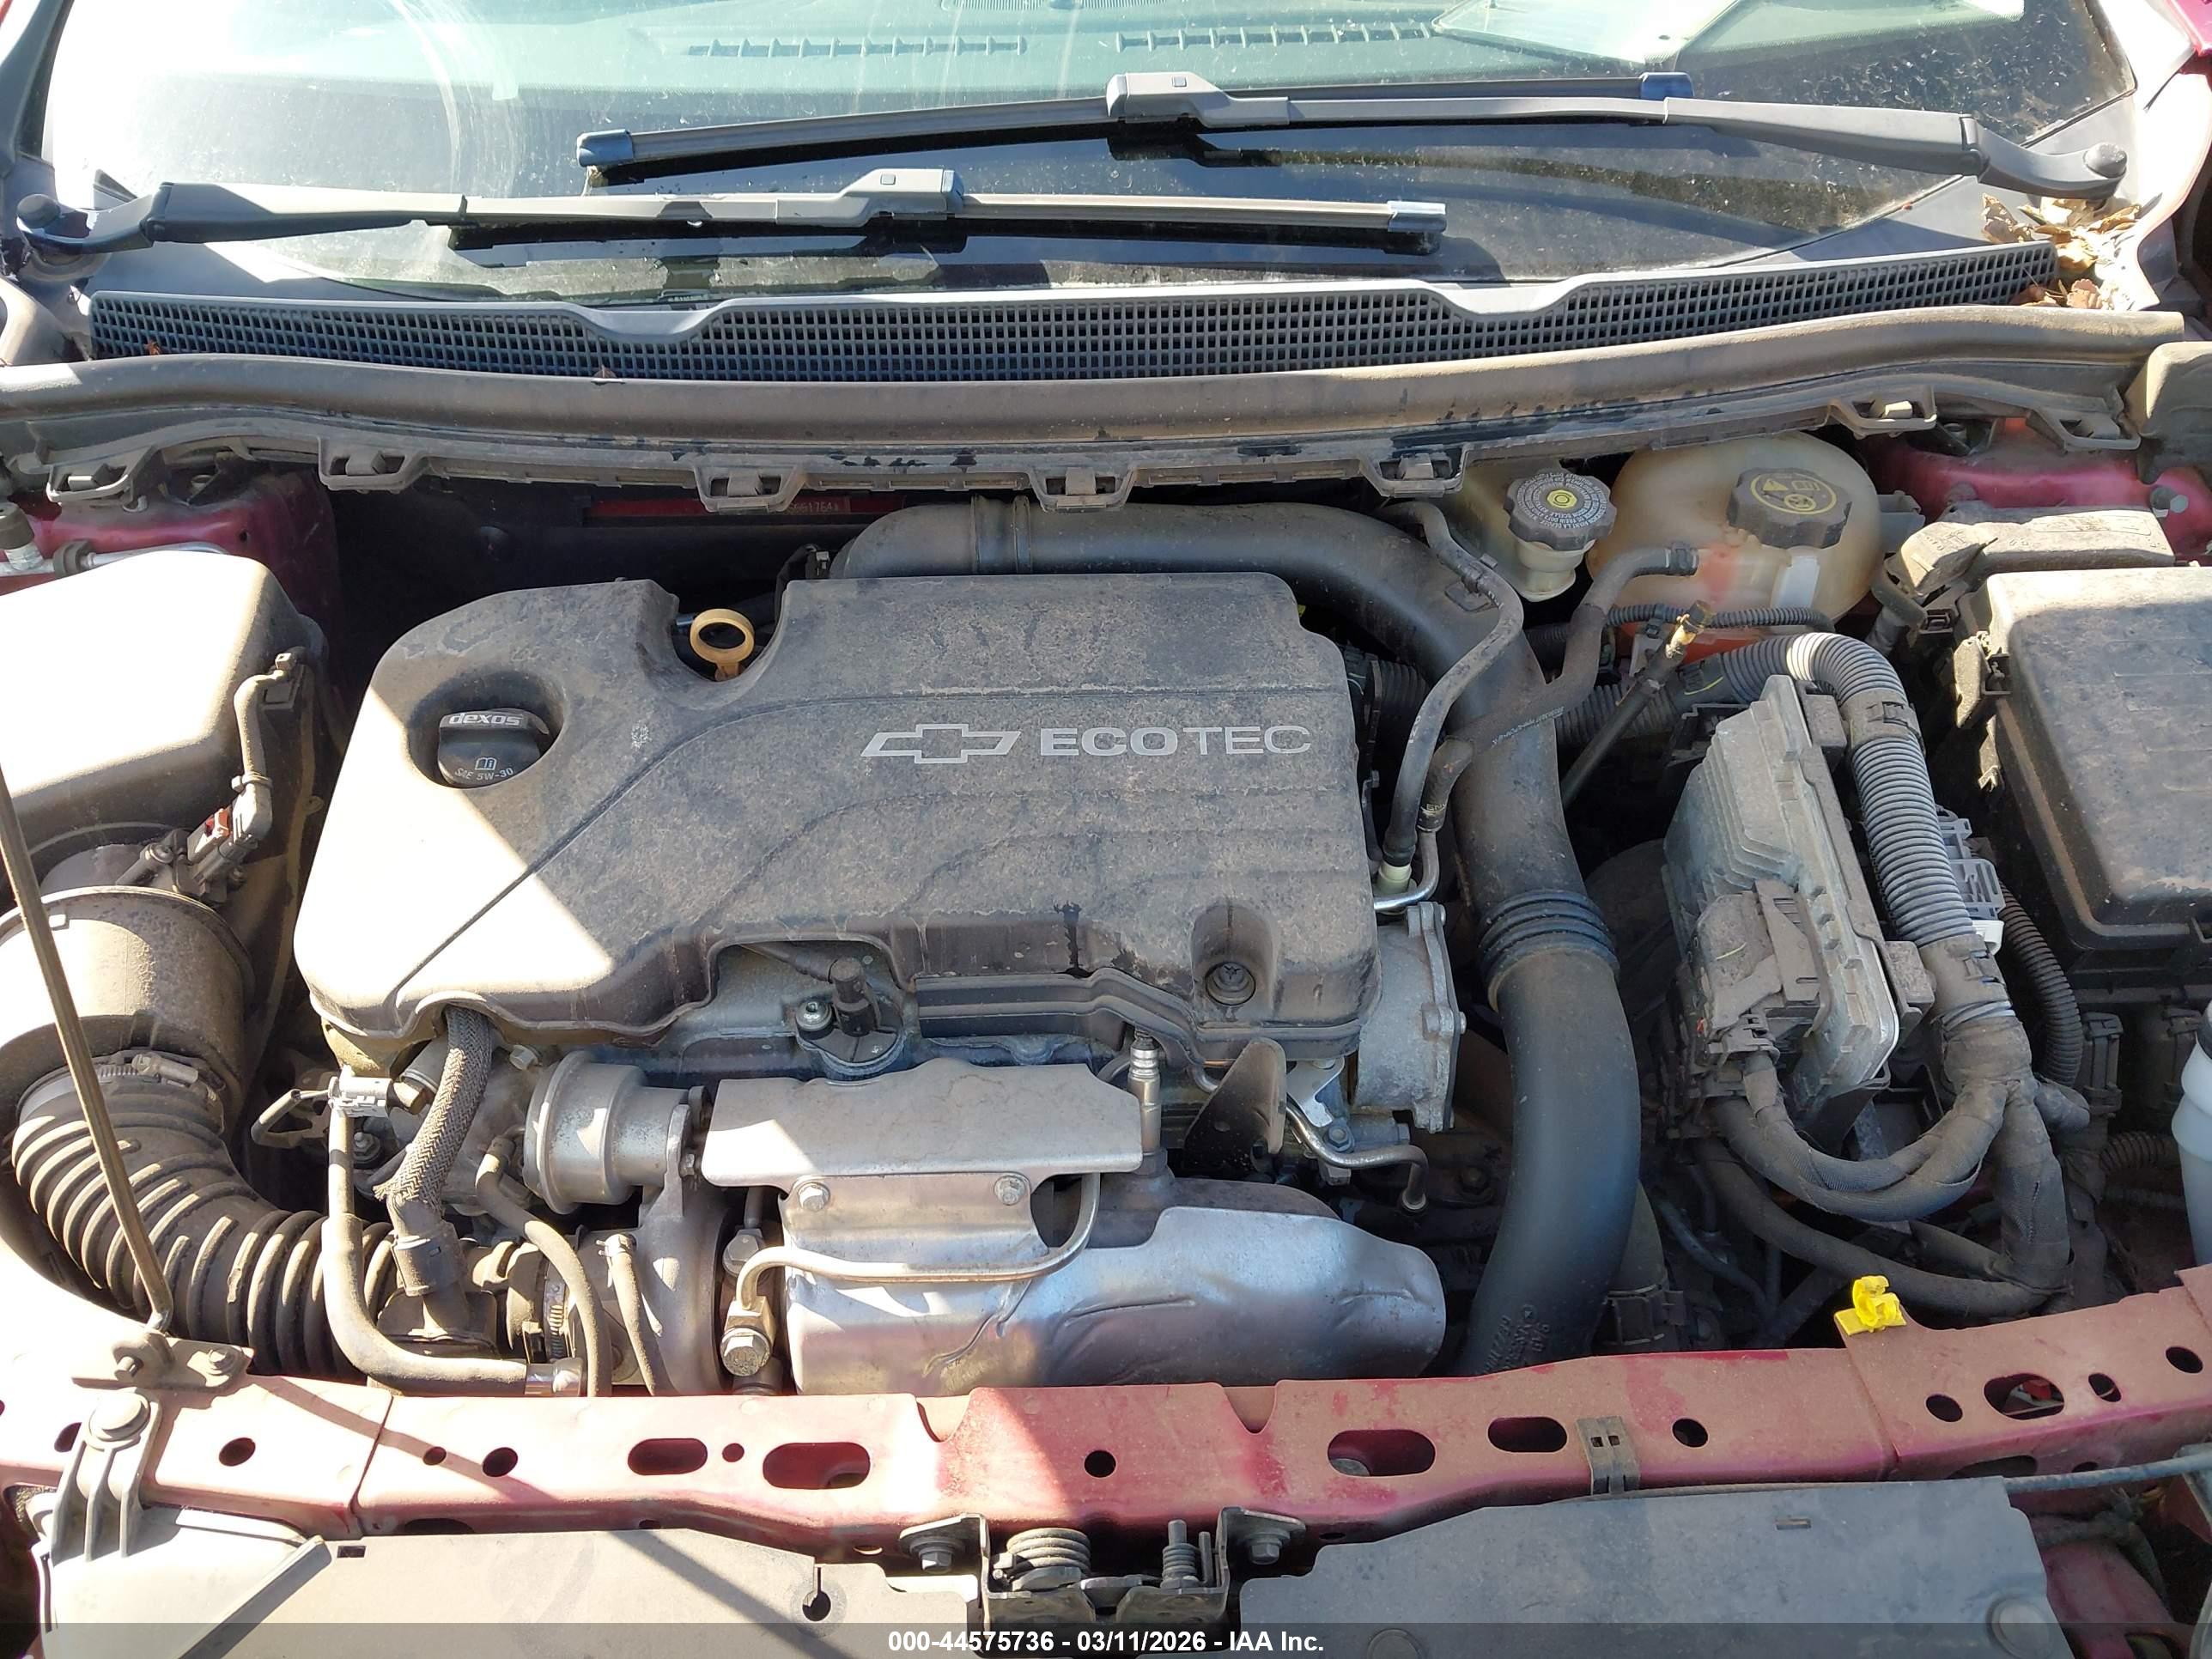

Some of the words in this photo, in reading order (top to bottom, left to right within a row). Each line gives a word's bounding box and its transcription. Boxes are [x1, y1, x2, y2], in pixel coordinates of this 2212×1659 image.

[449, 712, 523, 726] dexos
[1040, 726, 1311, 757] ECOTEC
[454, 768, 474, 781] SAE
[477, 768, 514, 781] 5W-30
